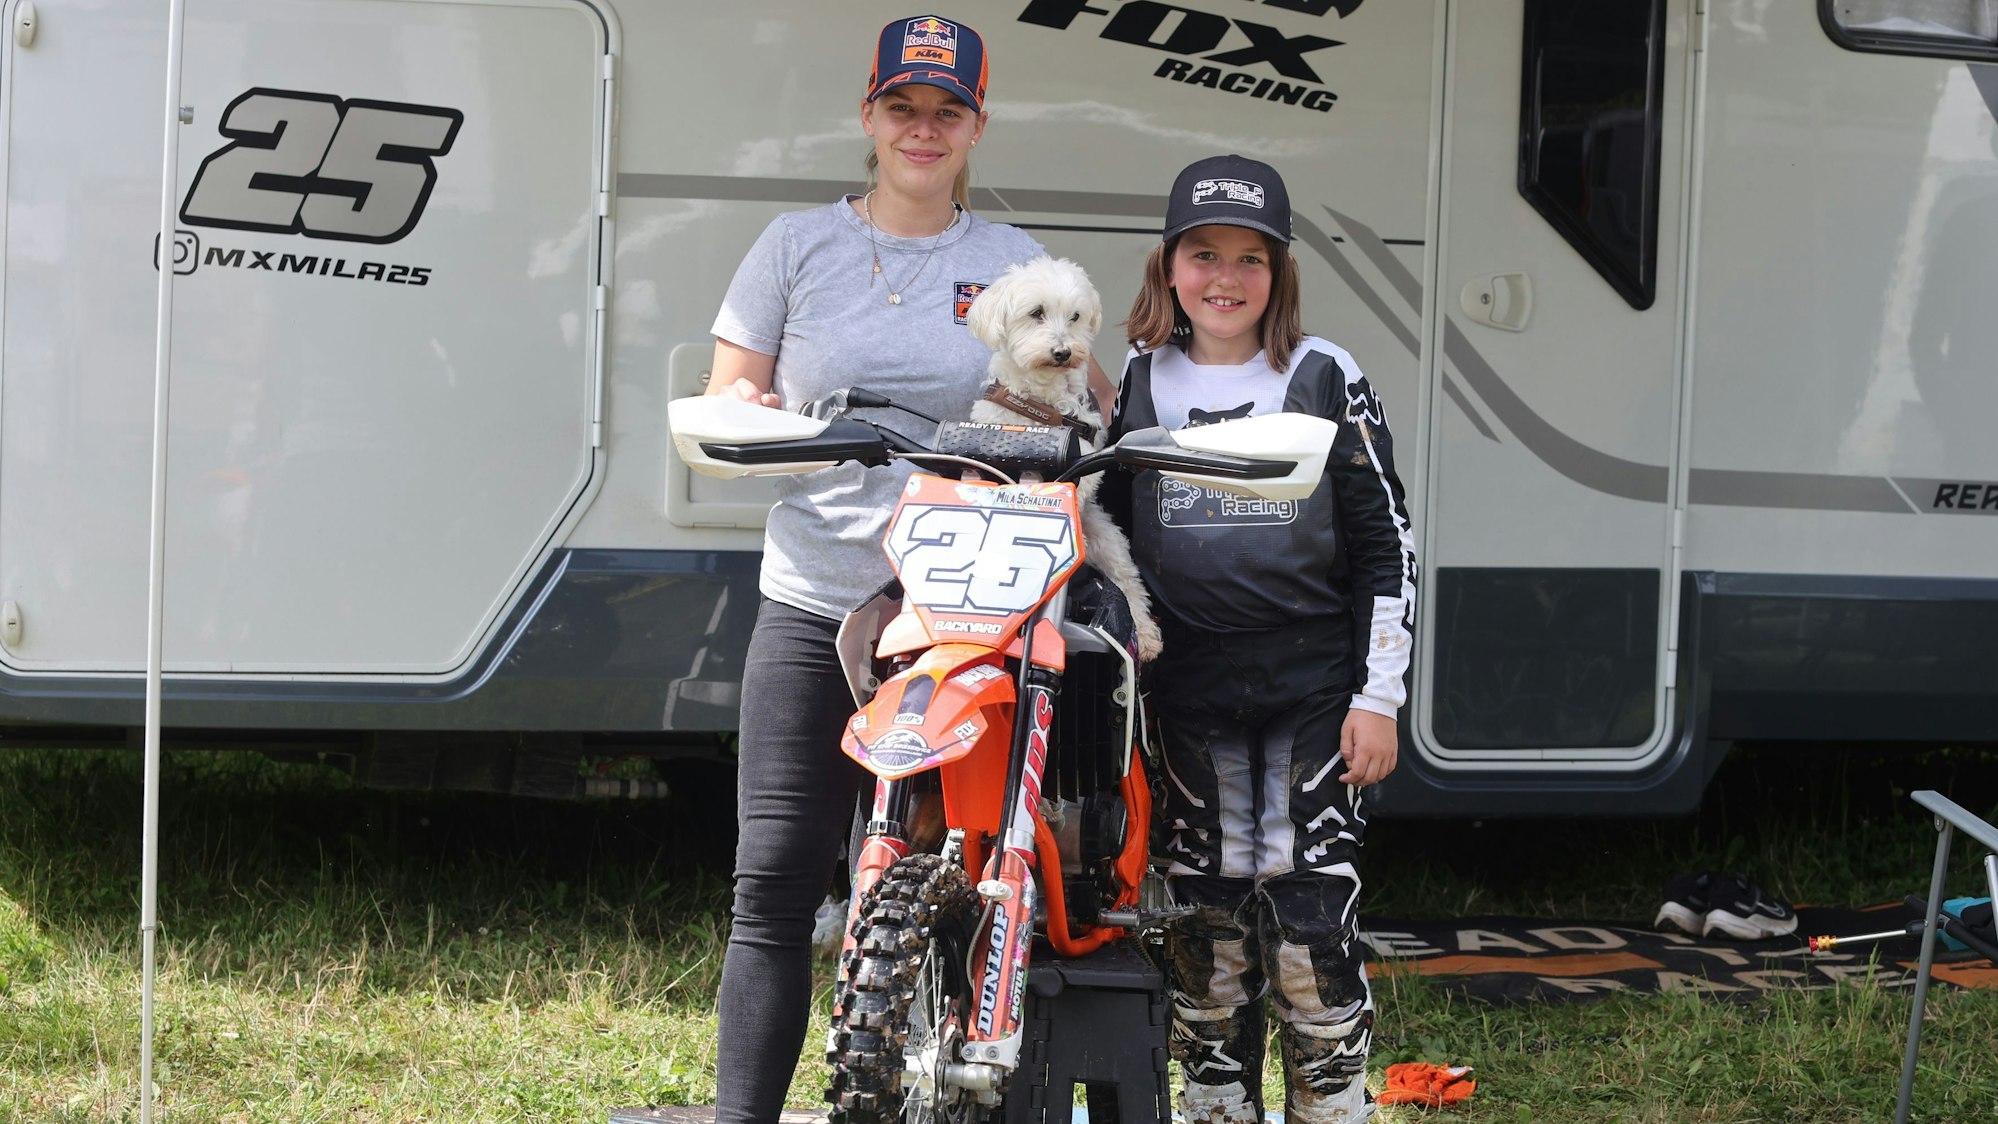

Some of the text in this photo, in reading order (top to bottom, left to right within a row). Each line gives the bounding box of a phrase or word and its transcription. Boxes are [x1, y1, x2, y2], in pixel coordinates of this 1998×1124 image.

[906, 34, 954, 50] Red Bull
[915, 49, 943, 60] KTM
[1153, 58, 1338, 113] RACING
[179, 87, 464, 245] 25
[1227, 190, 1262, 206] Racing
[958, 422, 988, 430] READY
[1025, 426, 1051, 434] RACE
[1221, 498, 1292, 519] Racing
[934, 620, 1003, 635] BACKYARD
[952, 719, 979, 741] FOX
[976, 903, 1010, 1037] DUNLOP
[1011, 970, 1025, 1020] MOTUL
